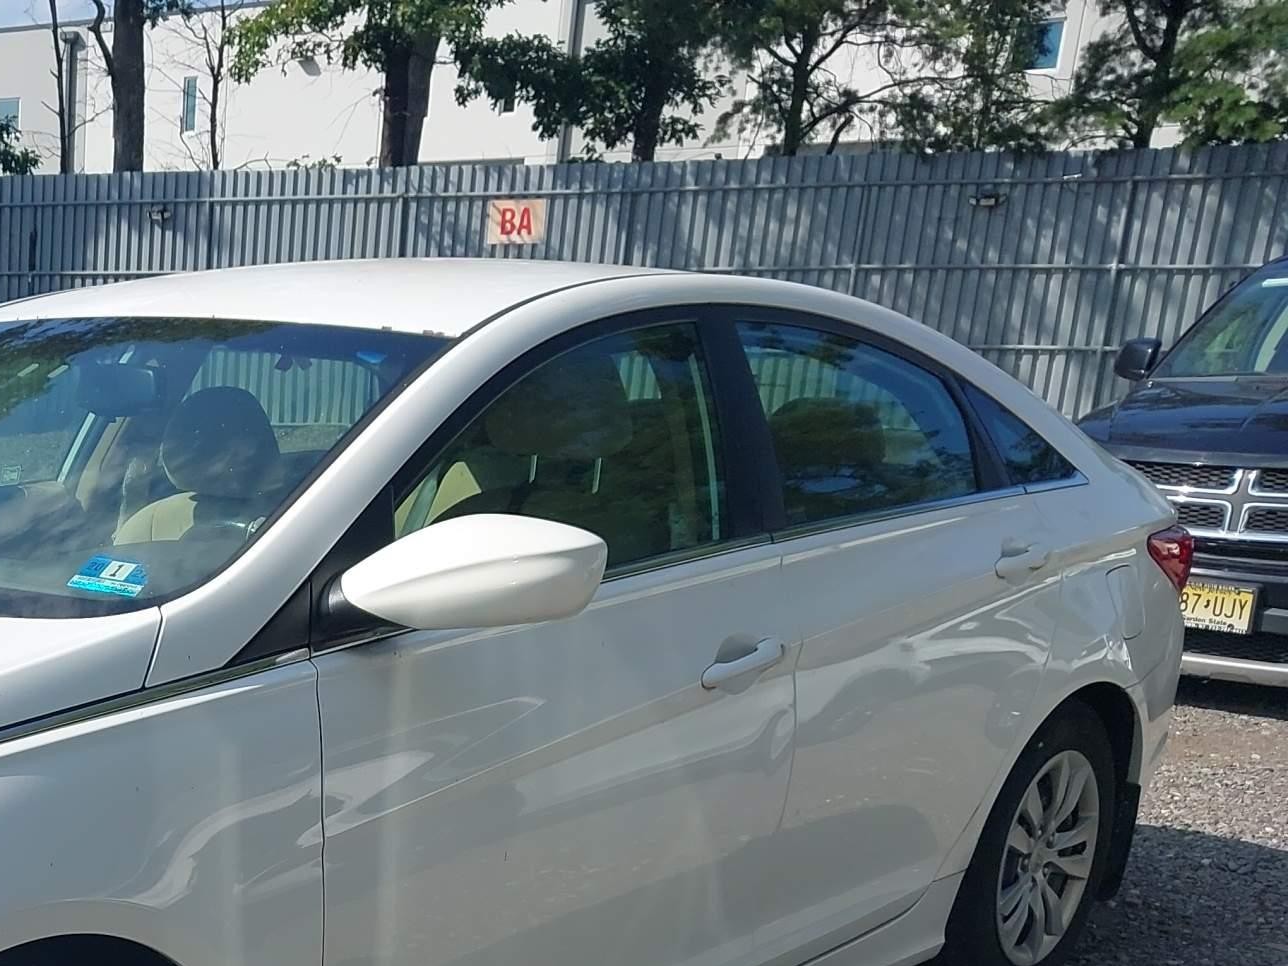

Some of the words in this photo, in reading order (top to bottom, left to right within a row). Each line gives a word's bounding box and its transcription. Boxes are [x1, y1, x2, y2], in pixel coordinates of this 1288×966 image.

[500, 207, 532, 235] BA
[109, 564, 124, 577] 1
[1213, 596, 1248, 620] UJY
[1209, 617, 1227, 625] State
